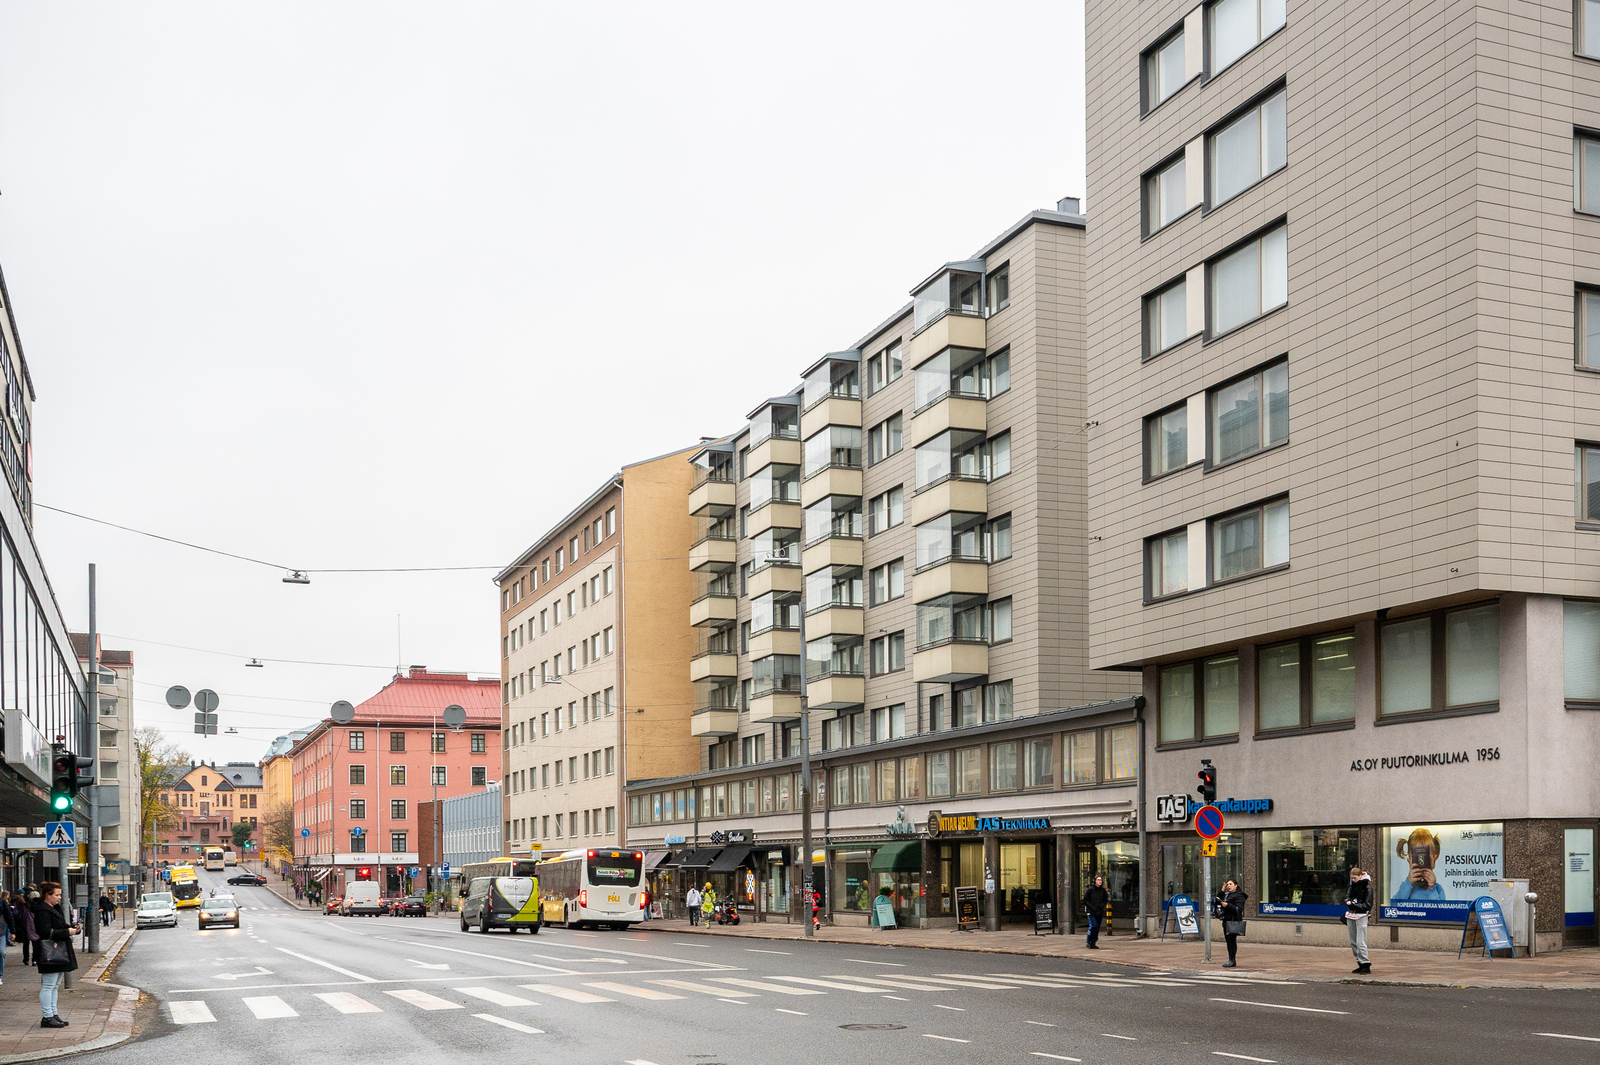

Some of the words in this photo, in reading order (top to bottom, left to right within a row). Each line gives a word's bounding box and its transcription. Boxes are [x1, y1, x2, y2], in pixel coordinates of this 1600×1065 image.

[1381, 751, 1470, 769] PUUTORINKULMA
[1476, 747, 1500, 761] 1956
[1159, 798, 1185, 819] JAS
[976, 816, 1000, 831] JAS
[1001, 818, 1048, 830] TEKNIIKKA
[1445, 854, 1498, 865] PASSIKUVAT
[1445, 868, 1462, 877] joihin
[1463, 868, 1485, 876] sinäkin
[1485, 868, 1498, 876] olet
